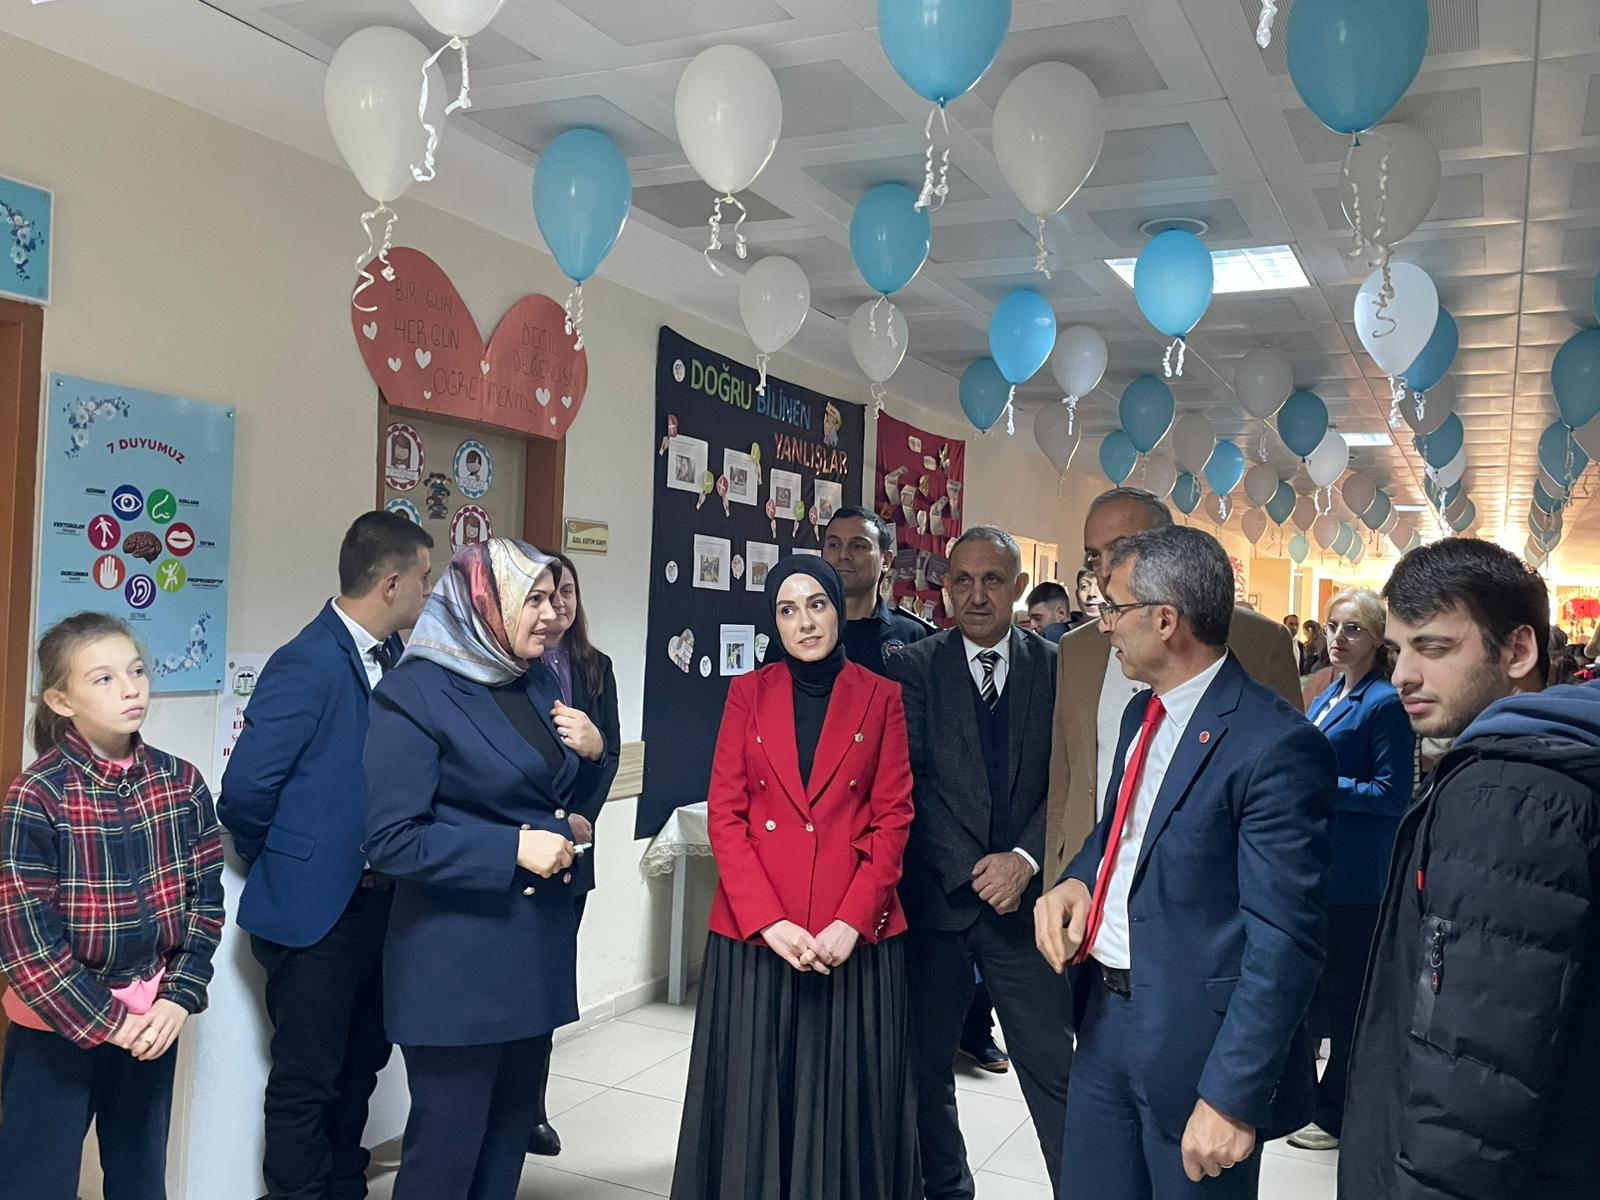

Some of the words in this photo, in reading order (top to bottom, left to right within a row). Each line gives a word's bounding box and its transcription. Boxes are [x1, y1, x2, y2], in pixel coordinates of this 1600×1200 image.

[690, 358, 752, 410] DOĞRU
[119, 437, 185, 465] DUYUMUZ
[774, 432, 848, 476] YANLIŞLAR
